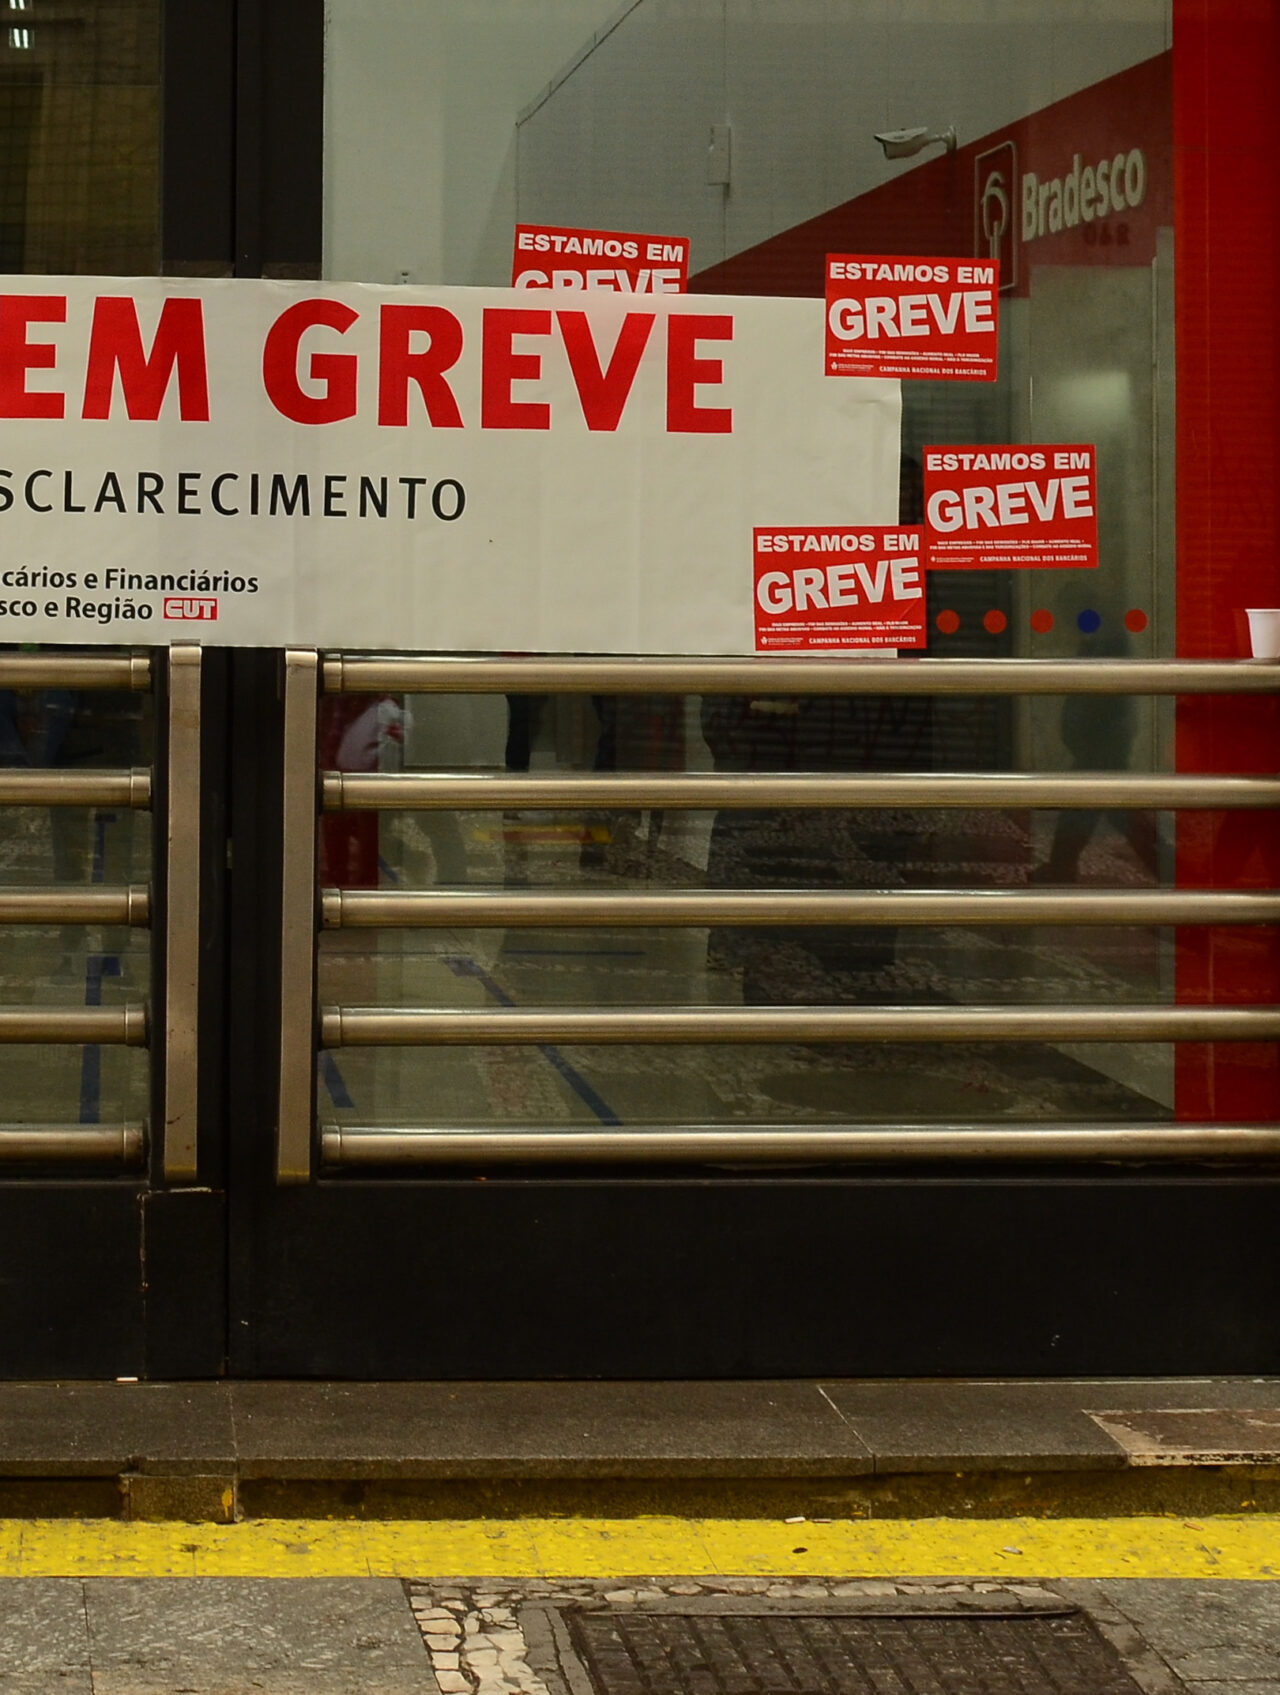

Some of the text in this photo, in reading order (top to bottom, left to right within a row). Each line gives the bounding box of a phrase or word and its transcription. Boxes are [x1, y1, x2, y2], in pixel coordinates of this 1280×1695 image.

[1022, 148, 1145, 242] Bradesco
[518, 232, 684, 262] ESTAMOS EM
[829, 262, 994, 285] ESTAMOS EM
[828, 290, 995, 341] GREVE
[262, 298, 734, 433] GREVE
[927, 452, 1090, 471] ESTAMOS EM
[927, 475, 1094, 533] GREVE
[757, 535, 876, 552] ESTAMOS
[883, 534, 919, 551] EM
[84, 572, 99, 589] e
[105, 568, 259, 593] Financiários
[756, 557, 922, 615] GREVE
[44, 601, 59, 617] e
[66, 596, 153, 624] Região
[165, 600, 216, 619] CUT
